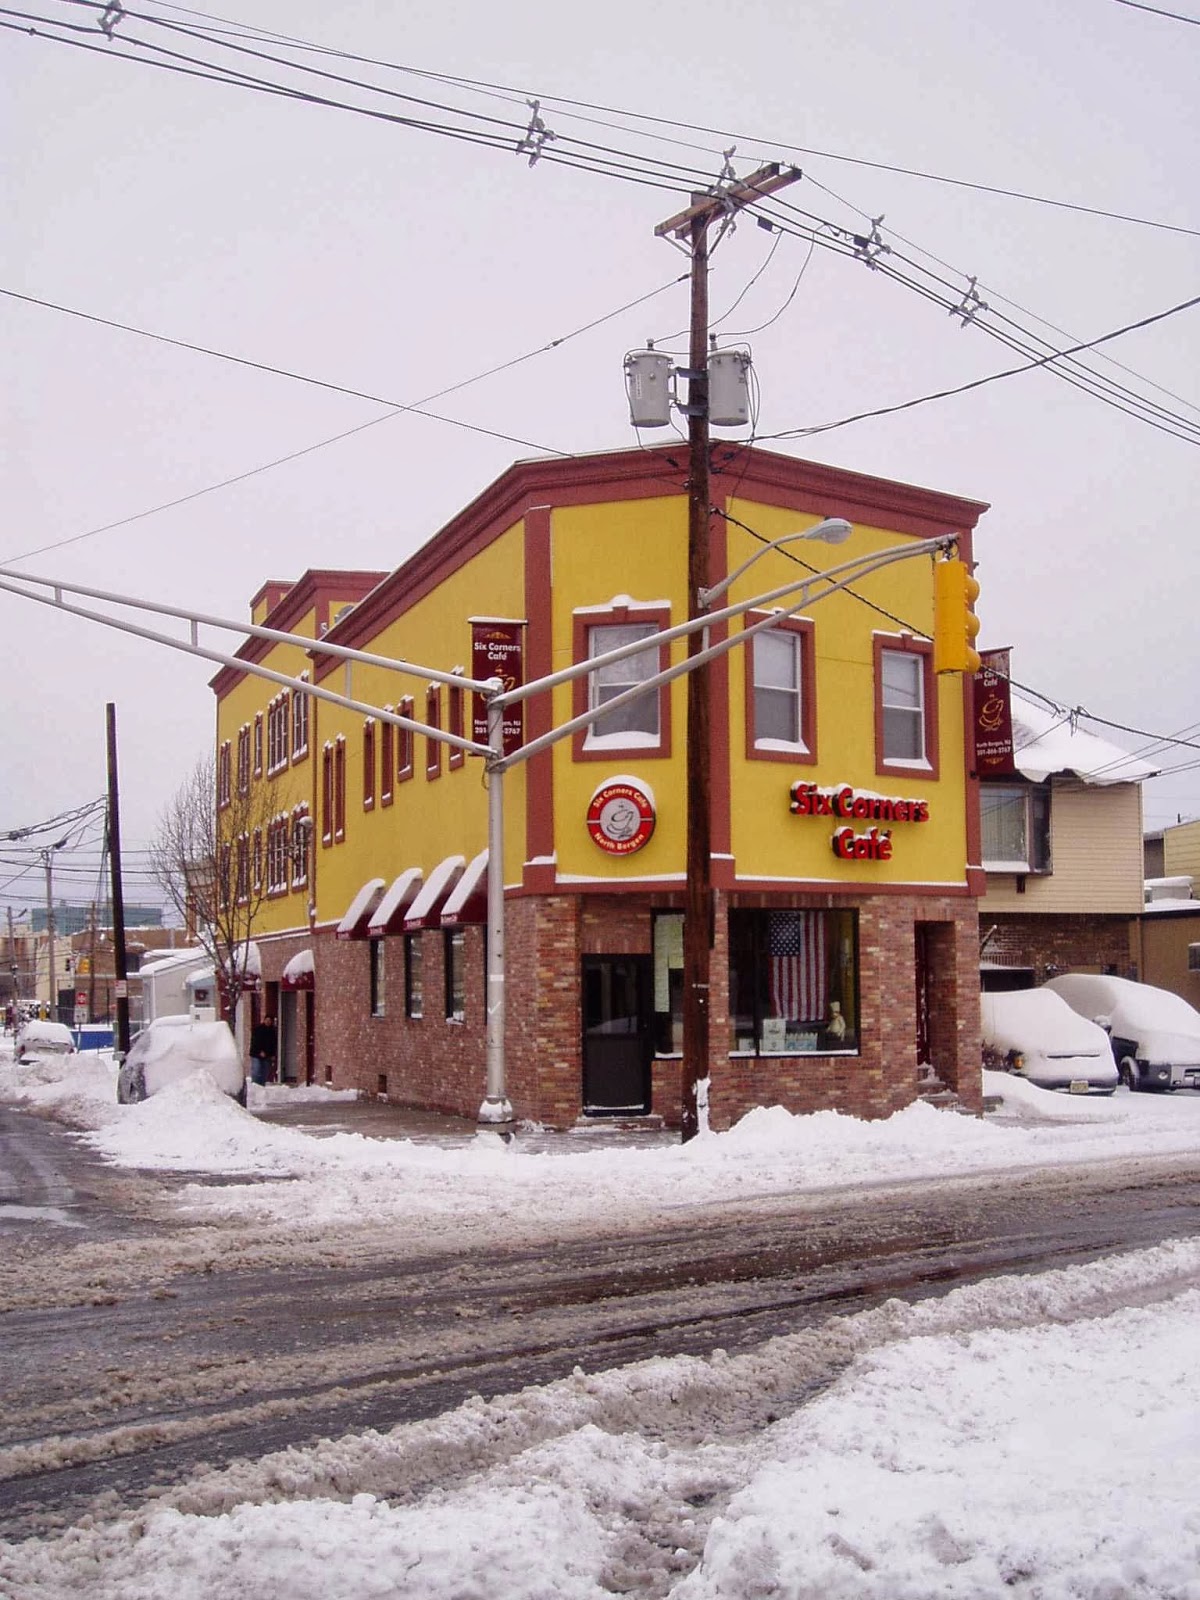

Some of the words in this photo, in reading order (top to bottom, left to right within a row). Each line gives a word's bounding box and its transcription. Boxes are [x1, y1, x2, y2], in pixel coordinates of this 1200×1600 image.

[474, 642, 487, 651] Six
[488, 642, 521, 652] Corners
[487, 651, 507, 661] Café
[593, 797, 604, 808] Six
[602, 788, 633, 798] Corners
[790, 783, 834, 815] Six
[834, 786, 929, 822] Corners
[594, 832, 615, 849] North
[617, 834, 644, 850] Bergen
[833, 828, 893, 860] Café
